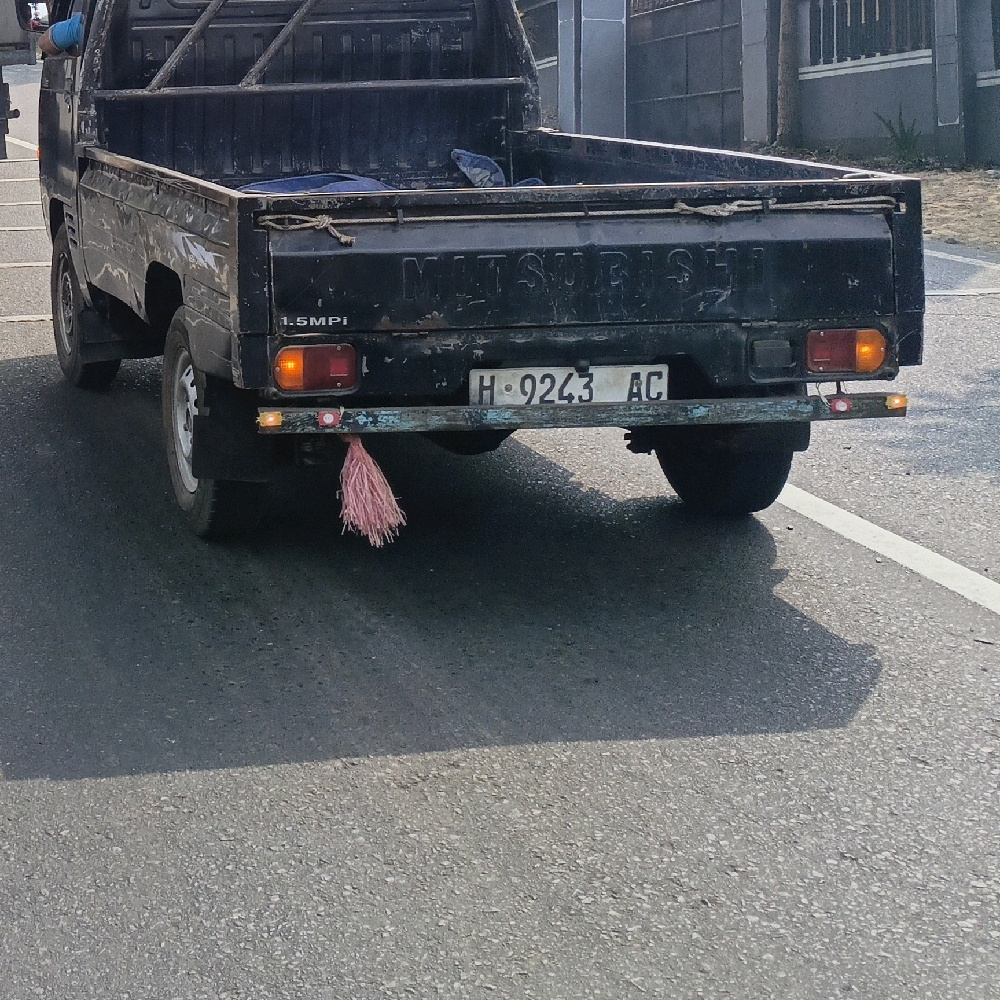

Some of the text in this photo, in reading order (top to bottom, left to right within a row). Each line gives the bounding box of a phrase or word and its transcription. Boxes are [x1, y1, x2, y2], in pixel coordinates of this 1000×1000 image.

[402, 247, 764, 300] MITSUBISHI
[280, 316, 348, 326] 1.5MPi
[478, 371, 664, 406] H 9243 AC
